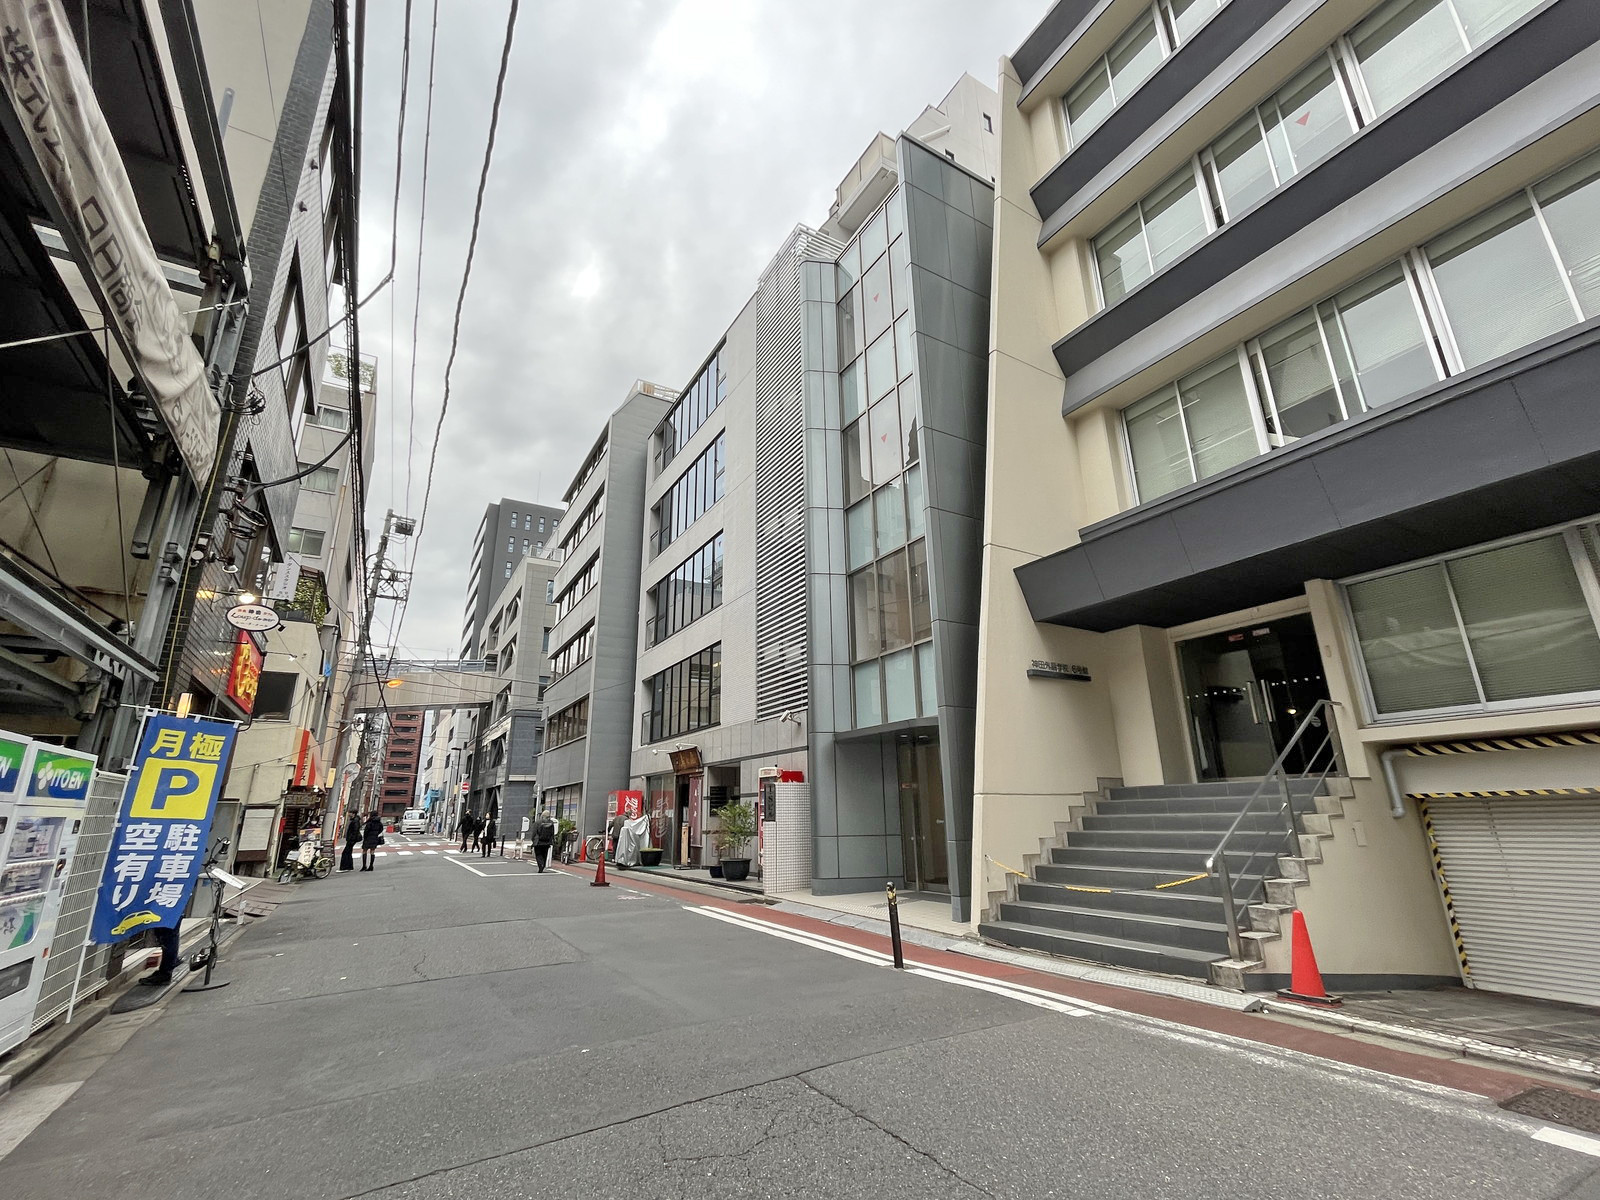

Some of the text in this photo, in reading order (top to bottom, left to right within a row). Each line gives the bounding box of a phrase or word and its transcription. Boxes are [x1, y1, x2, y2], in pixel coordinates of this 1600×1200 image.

[150, 728, 226, 760] 月極
[150, 768, 200, 810] P
[112, 822, 163, 912] 空有り
[144, 823, 201, 908] 駐車場
